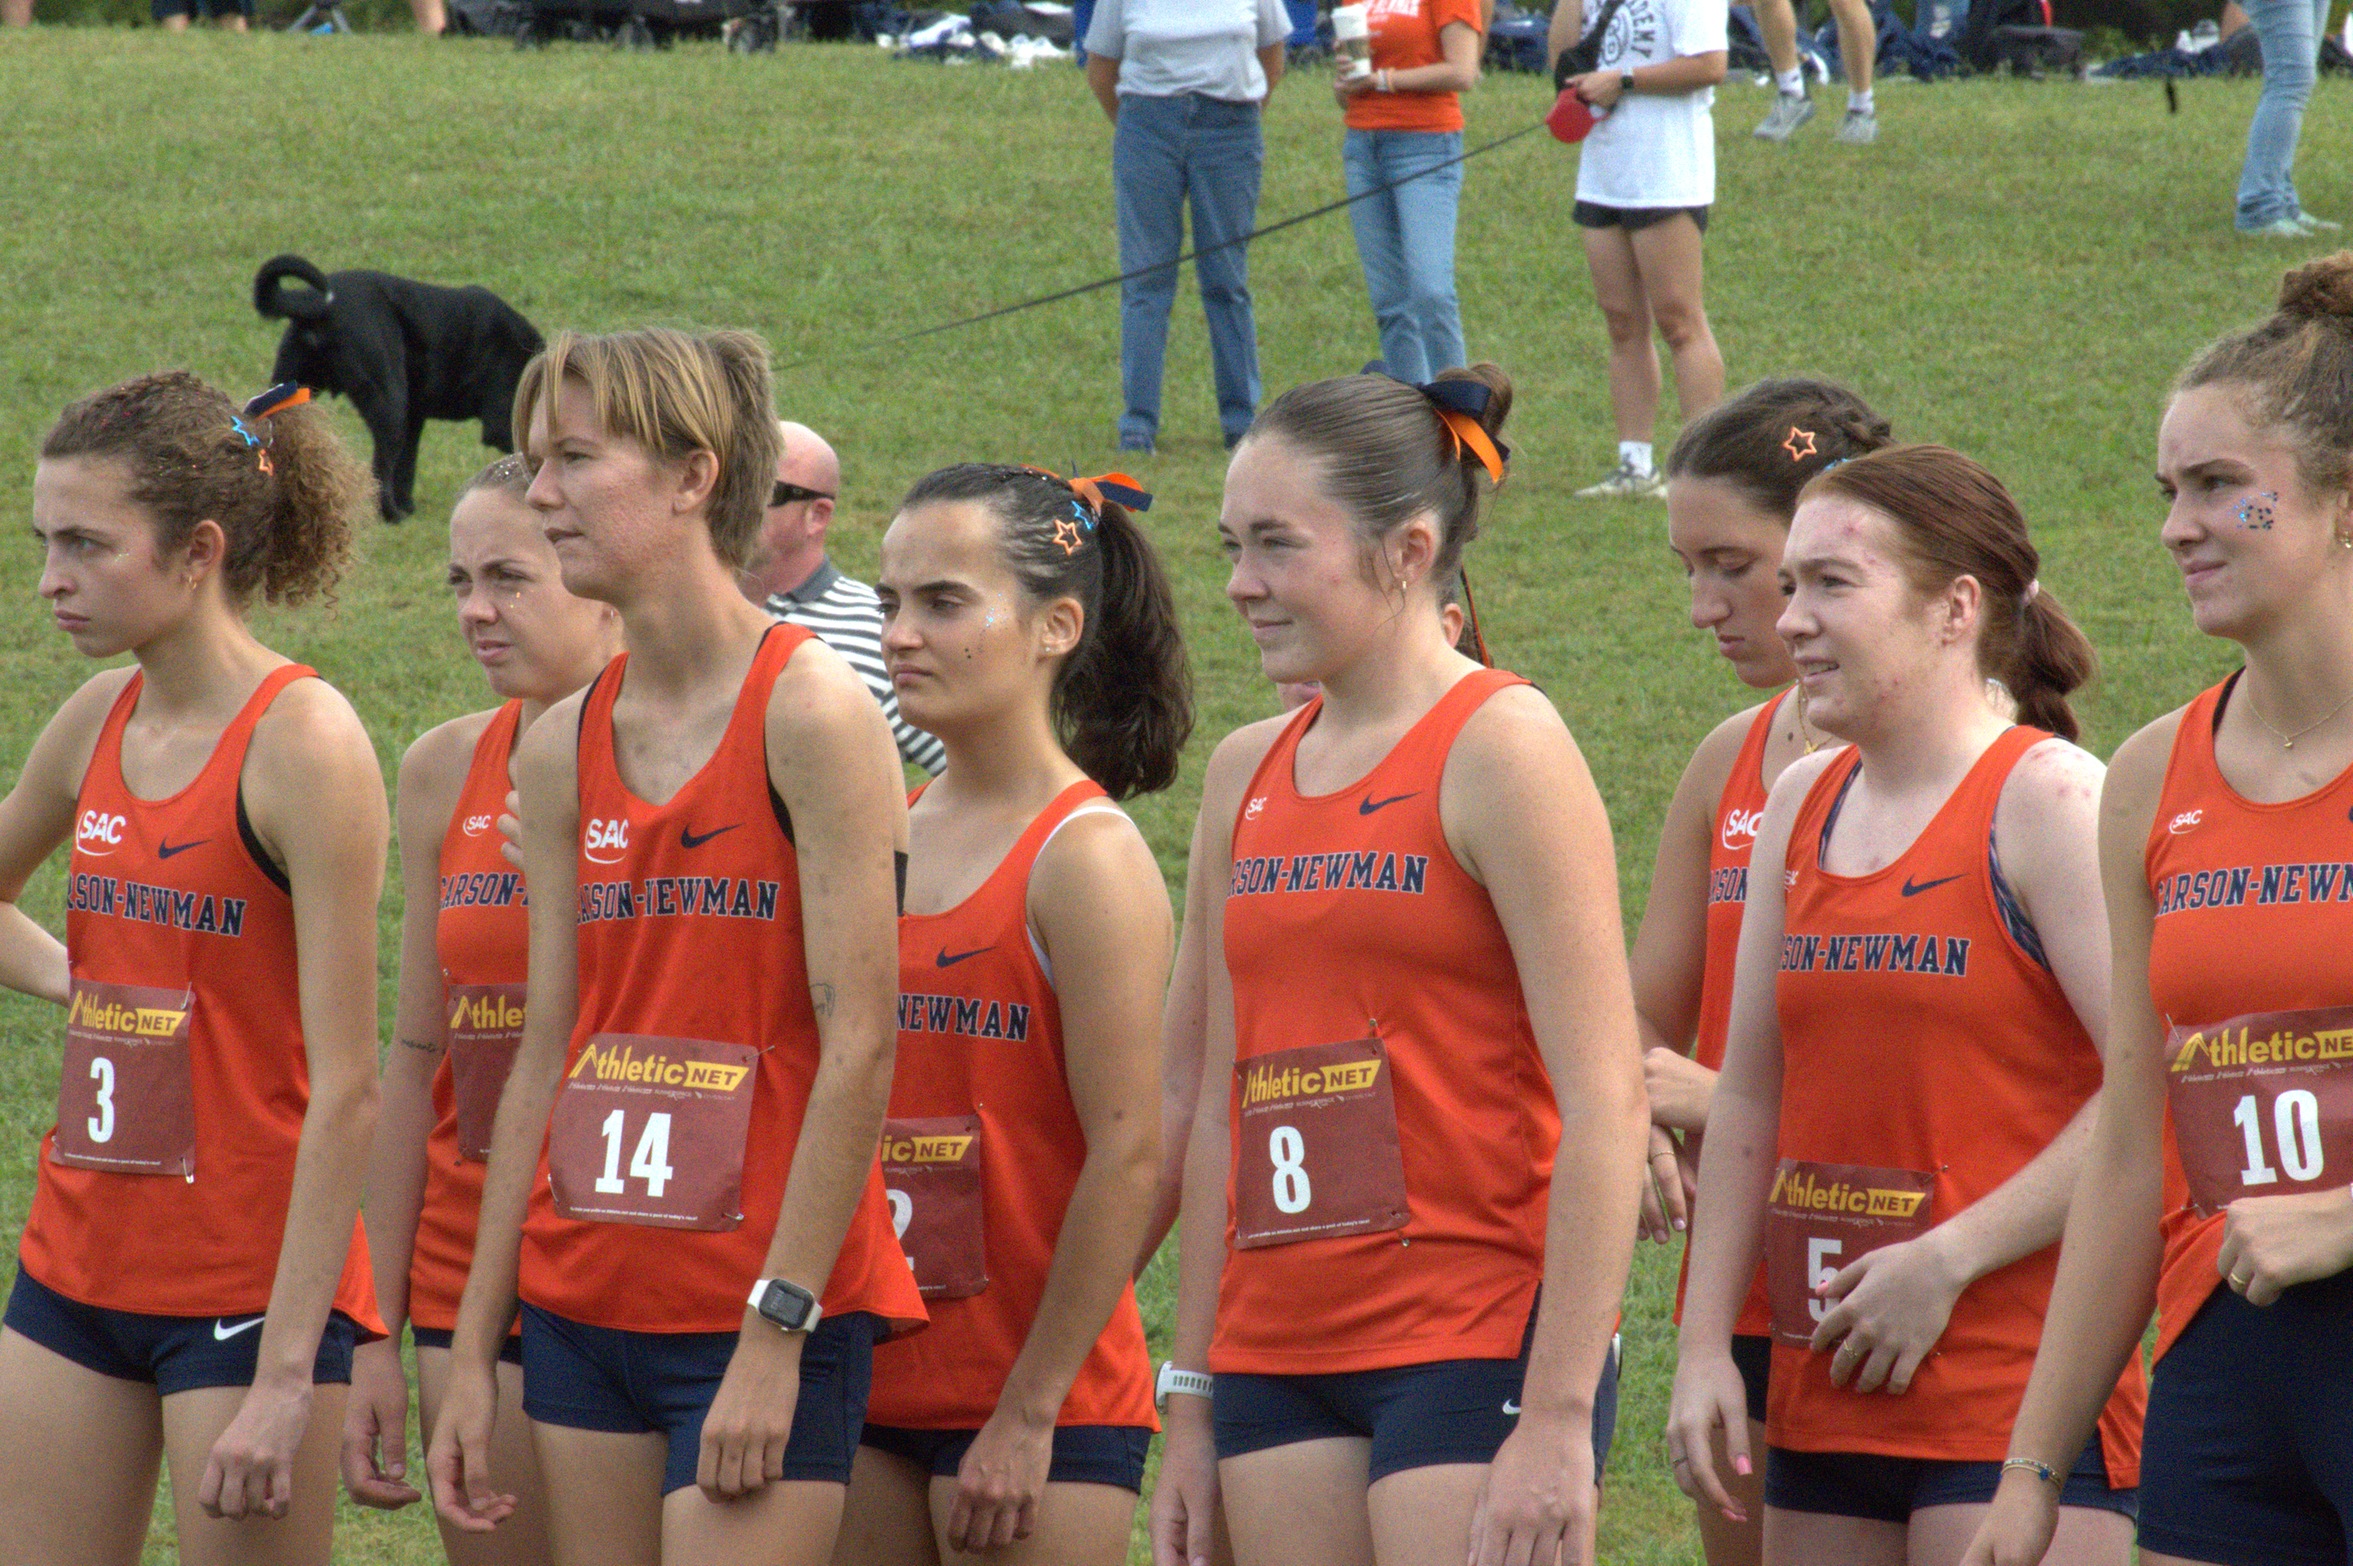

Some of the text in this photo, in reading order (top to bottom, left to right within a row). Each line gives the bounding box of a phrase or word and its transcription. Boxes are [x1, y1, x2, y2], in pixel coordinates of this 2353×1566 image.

[80, 810, 126, 844] SAC
[467, 815, 491, 830] SAC
[587, 818, 629, 849] SAC
[1726, 809, 1763, 837] SAC
[2173, 810, 2203, 828] SAC
[68, 990, 176, 1032] Athletic NET
[450, 994, 527, 1029] Athle
[568, 1043, 738, 1086] Athletic NET
[2171, 1026, 2317, 1072] Athletic
[87, 1056, 115, 1143] 3
[1241, 1063, 1322, 1109] Athletic
[1330, 1067, 1372, 1087] NET
[595, 1109, 673, 1197] 14
[920, 1142, 962, 1157] NET
[2233, 1089, 2324, 1186] 10
[1269, 1126, 1312, 1214] 8
[1769, 1169, 1915, 1213] Athletic NET
[1808, 1237, 1842, 1323] 5
